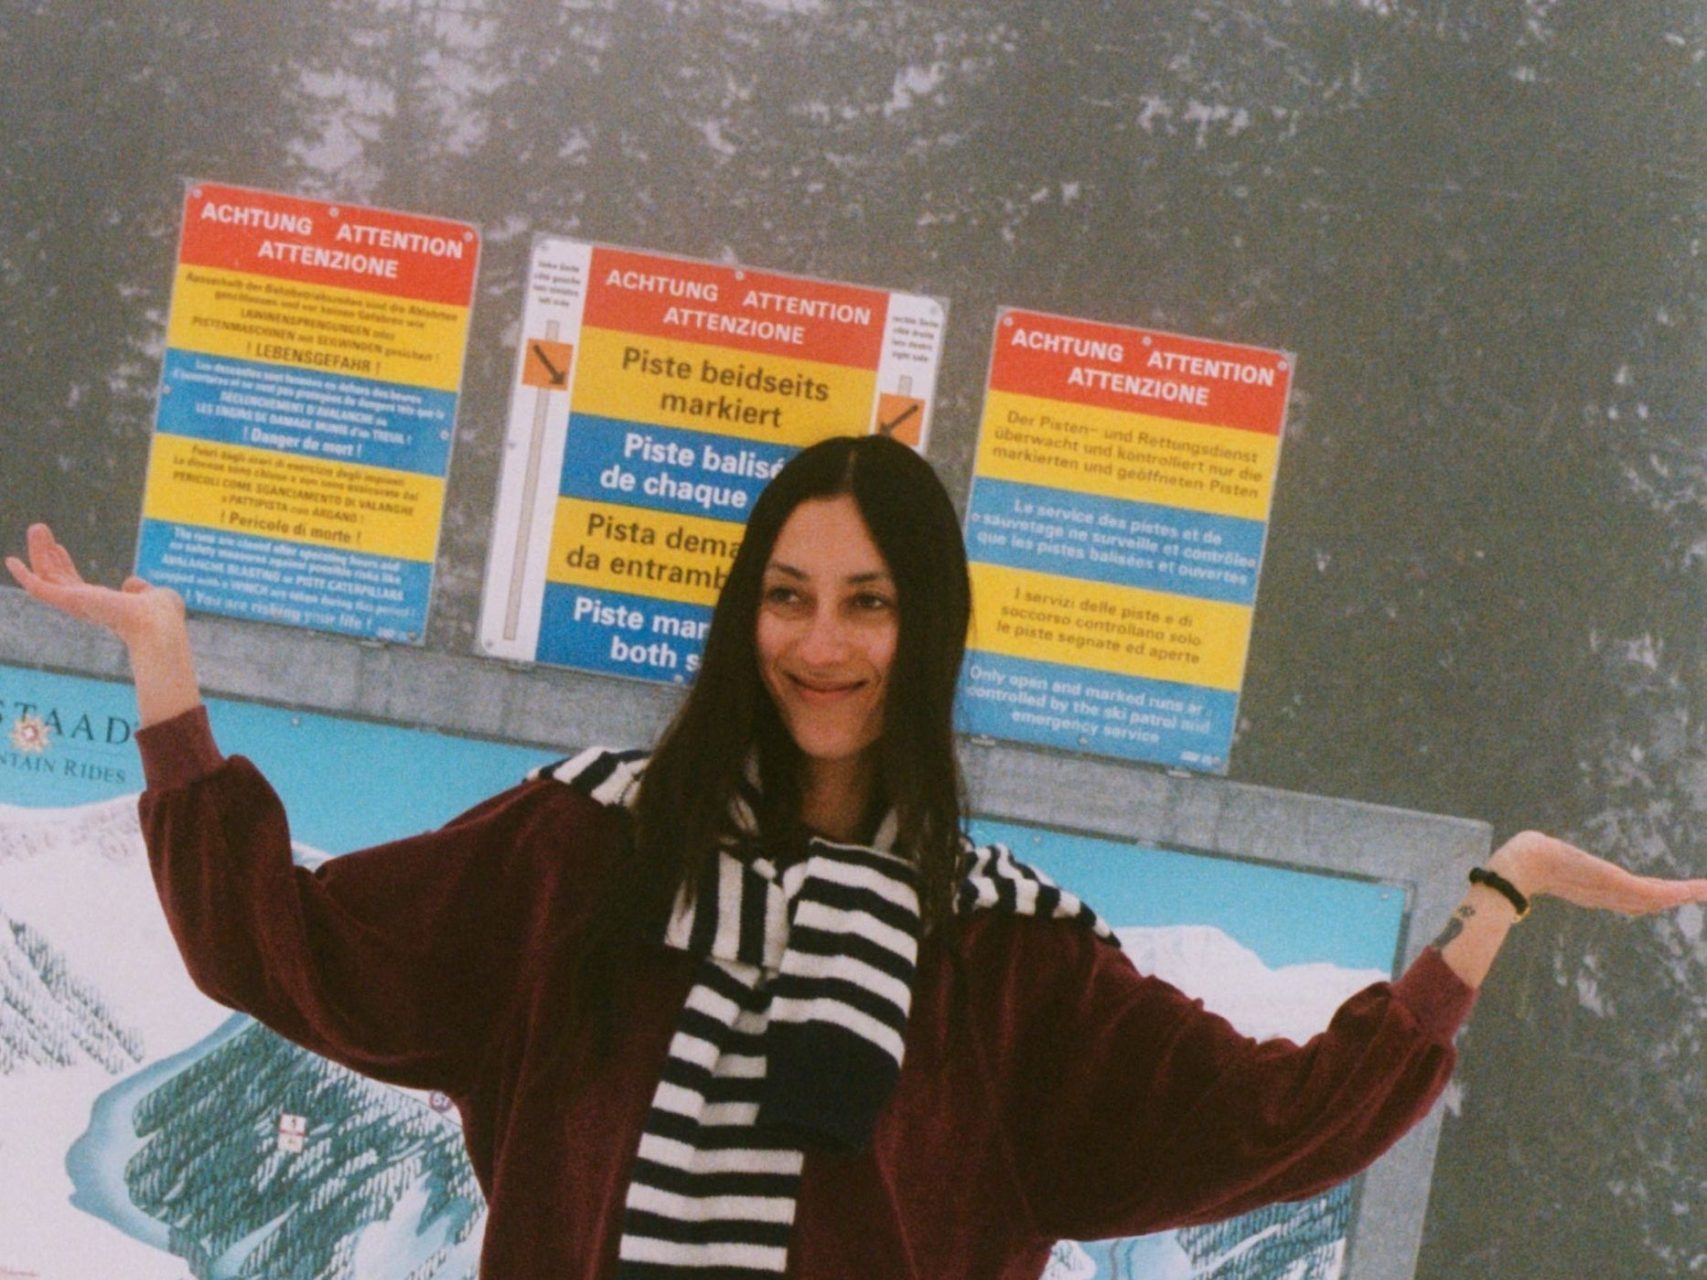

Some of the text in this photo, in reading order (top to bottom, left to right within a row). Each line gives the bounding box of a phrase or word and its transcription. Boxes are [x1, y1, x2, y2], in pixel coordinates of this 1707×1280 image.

[200, 202, 463, 258] ACHTUNG ATTENTION
[257, 239, 399, 278] ATTENZIONE
[605, 268, 719, 303] ACHTUNG
[741, 289, 872, 326] ATTENTION
[662, 305, 805, 345] ATTENZIONE
[255, 342, 371, 372] LEBENSGEFAHR
[621, 346, 831, 402] Piste beidseits
[1011, 328, 1275, 386] ACHTUNG ATTENTION
[1067, 366, 1210, 406] ATTENZIONE
[659, 387, 783, 427] markiert
[250, 426, 300, 450] Danger
[302, 435, 320, 451] de
[623, 432, 697, 467] Piste
[994, 425, 1263, 482] überwacht und kontrolliert nur die
[1006, 409, 1258, 465] Der Pisten- und Rettungsdienst
[598, 462, 749, 514] de chaque
[992, 443, 1258, 498] markierten und geöffneten Pisten
[228, 511, 289, 533] Pericolo
[292, 521, 306, 536] di
[310, 525, 351, 543] morte
[586, 513, 657, 545] Pista
[981, 512, 1064, 540] sauvetage
[1067, 528, 1088, 541] ne
[1090, 529, 1158, 553] surveille
[1162, 542, 1179, 556] et
[1013, 498, 1223, 545] Le service des pistes et de
[565, 543, 601, 571] da
[975, 530, 1248, 585] que les pistes balisées et ouvertes
[573, 596, 645, 630] Piste
[1000, 605, 1202, 646] soccorso controllano solo
[1024, 590, 1074, 608] servizi
[1079, 597, 1117, 615] delle
[1120, 606, 1160, 624] piste
[1164, 614, 1174, 624] e
[1177, 614, 1193, 627] di
[609, 635, 678, 668] both
[996, 619, 1199, 666] le piste segnate ed aperte
[965, 683, 1046, 707] controlled
[1049, 695, 1068, 713] by
[1073, 699, 1099, 716] the
[1103, 705, 1127, 720] ski
[1129, 709, 1177, 730] patrol
[969, 663, 1006, 685] Only
[1008, 674, 1048, 692] open
[1051, 679, 1082, 696] and
[1084, 684, 1145, 706] marked
[1148, 696, 1184, 712] runs
[0, 700, 131, 745] TAAD
[1010, 711, 1159, 744] emergency service
[64, 757, 126, 784] RIDES
